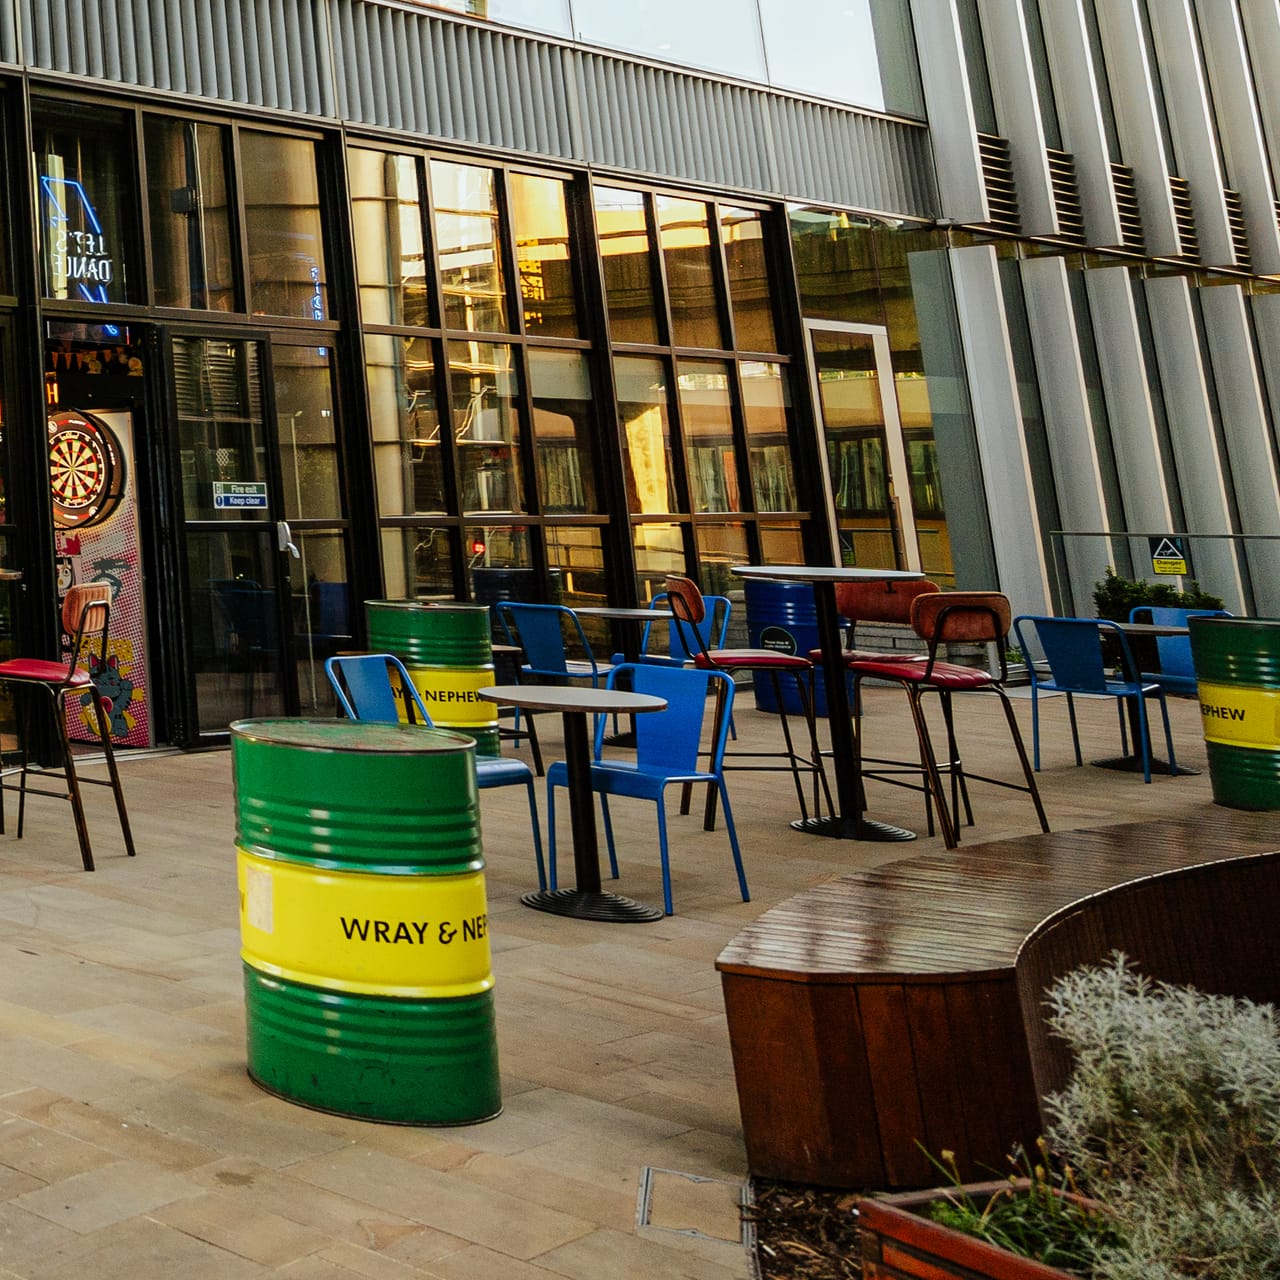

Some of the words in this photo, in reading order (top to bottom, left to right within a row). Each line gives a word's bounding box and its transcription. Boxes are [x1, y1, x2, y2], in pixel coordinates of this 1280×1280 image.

[229, 496, 245, 506] Keep
[1201, 703, 1246, 722] EPHEW
[340, 916, 429, 945] WRAY
[438, 920, 458, 945] &
[462, 914, 487, 943] NEP
